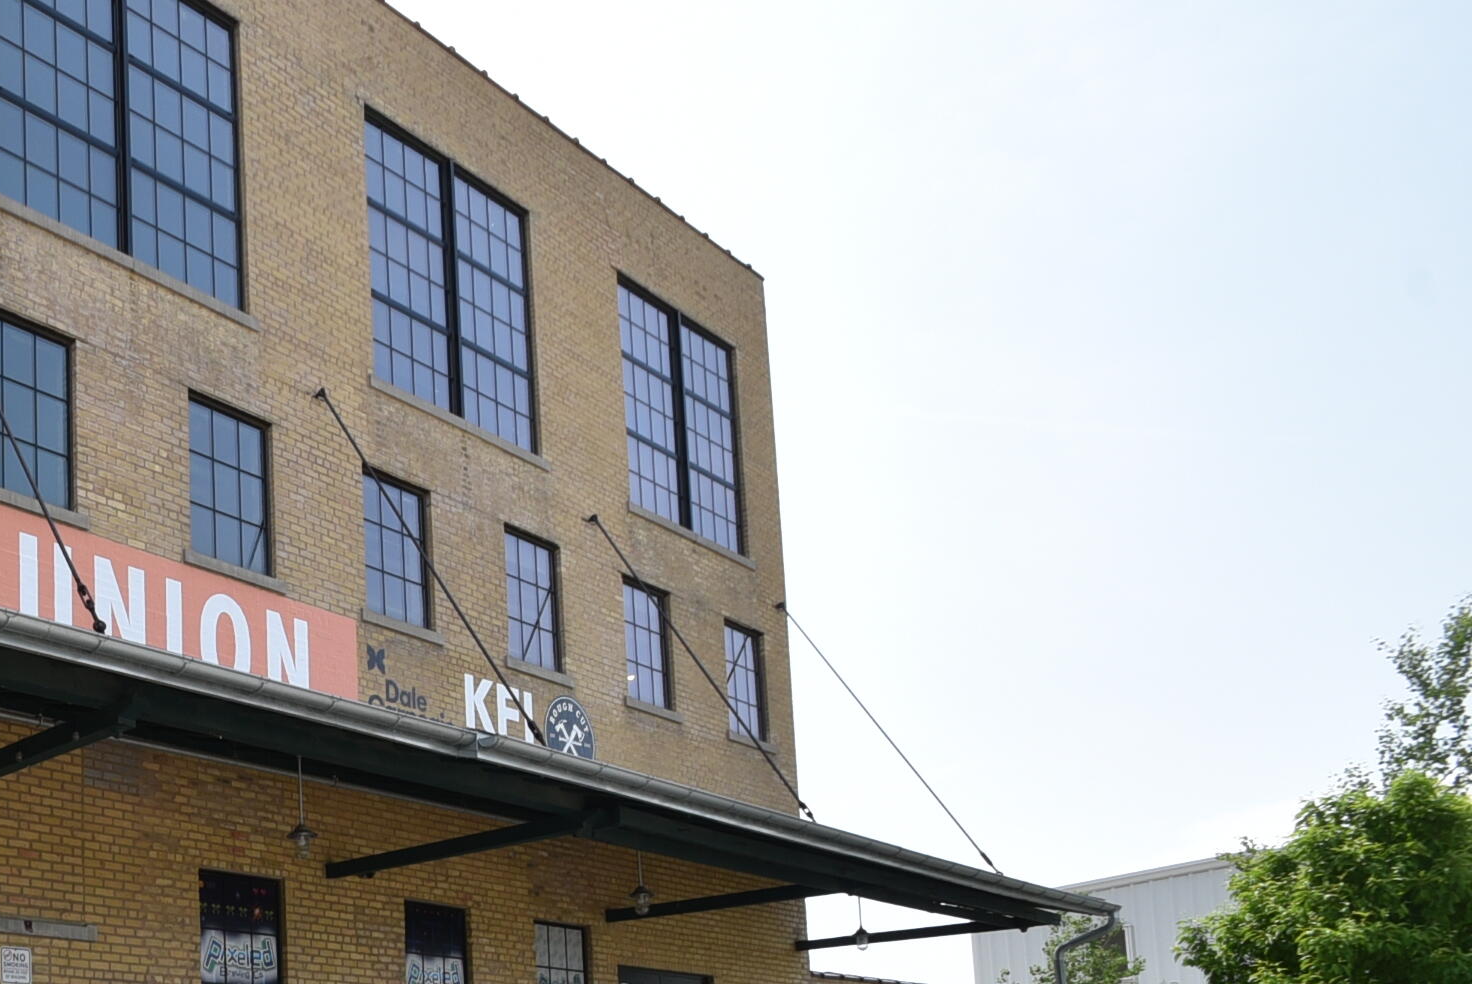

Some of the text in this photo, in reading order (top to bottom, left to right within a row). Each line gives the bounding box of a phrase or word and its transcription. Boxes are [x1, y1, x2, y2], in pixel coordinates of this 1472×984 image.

[385, 679, 428, 712] Dale
[549, 702, 590, 733] ROUGH CUT
[13, 952, 26, 962] NO
